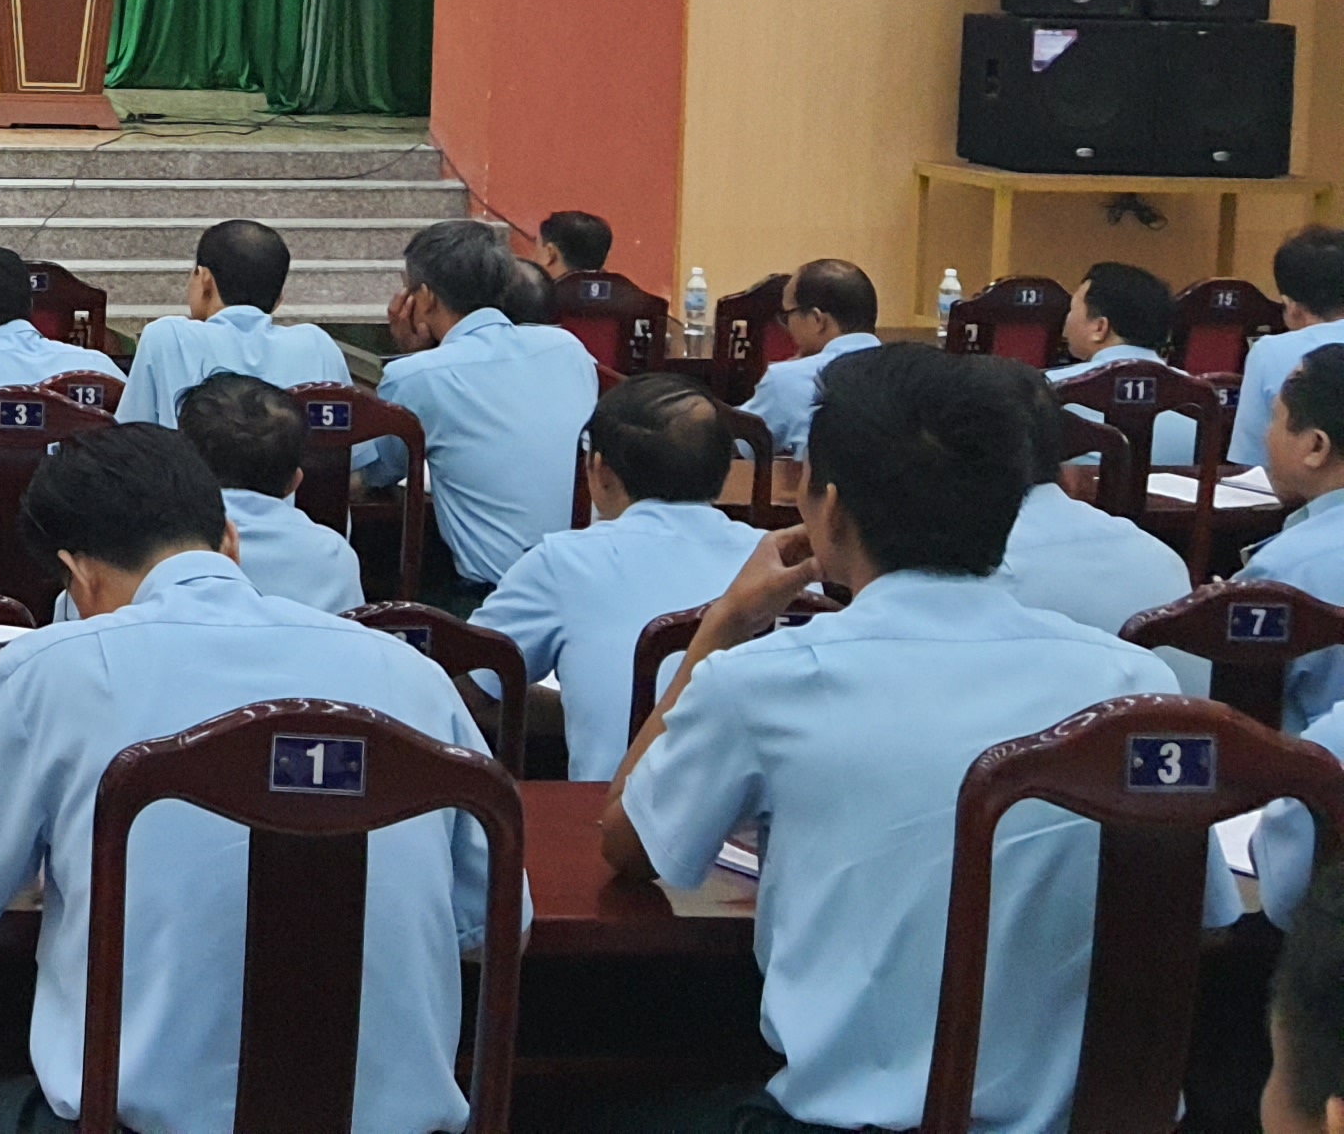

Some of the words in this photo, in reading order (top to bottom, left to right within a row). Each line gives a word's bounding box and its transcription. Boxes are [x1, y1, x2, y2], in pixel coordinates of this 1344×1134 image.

[590, 282, 600, 298] 9
[1021, 290, 1037, 303] 13
[75, 387, 96, 404] 13
[1124, 381, 1146, 400] 11
[14, 404, 28, 426] 3
[321, 405, 334, 426] 5
[1250, 608, 1268, 636] 7
[305, 742, 326, 785] 1
[1157, 742, 1184, 785] 3
